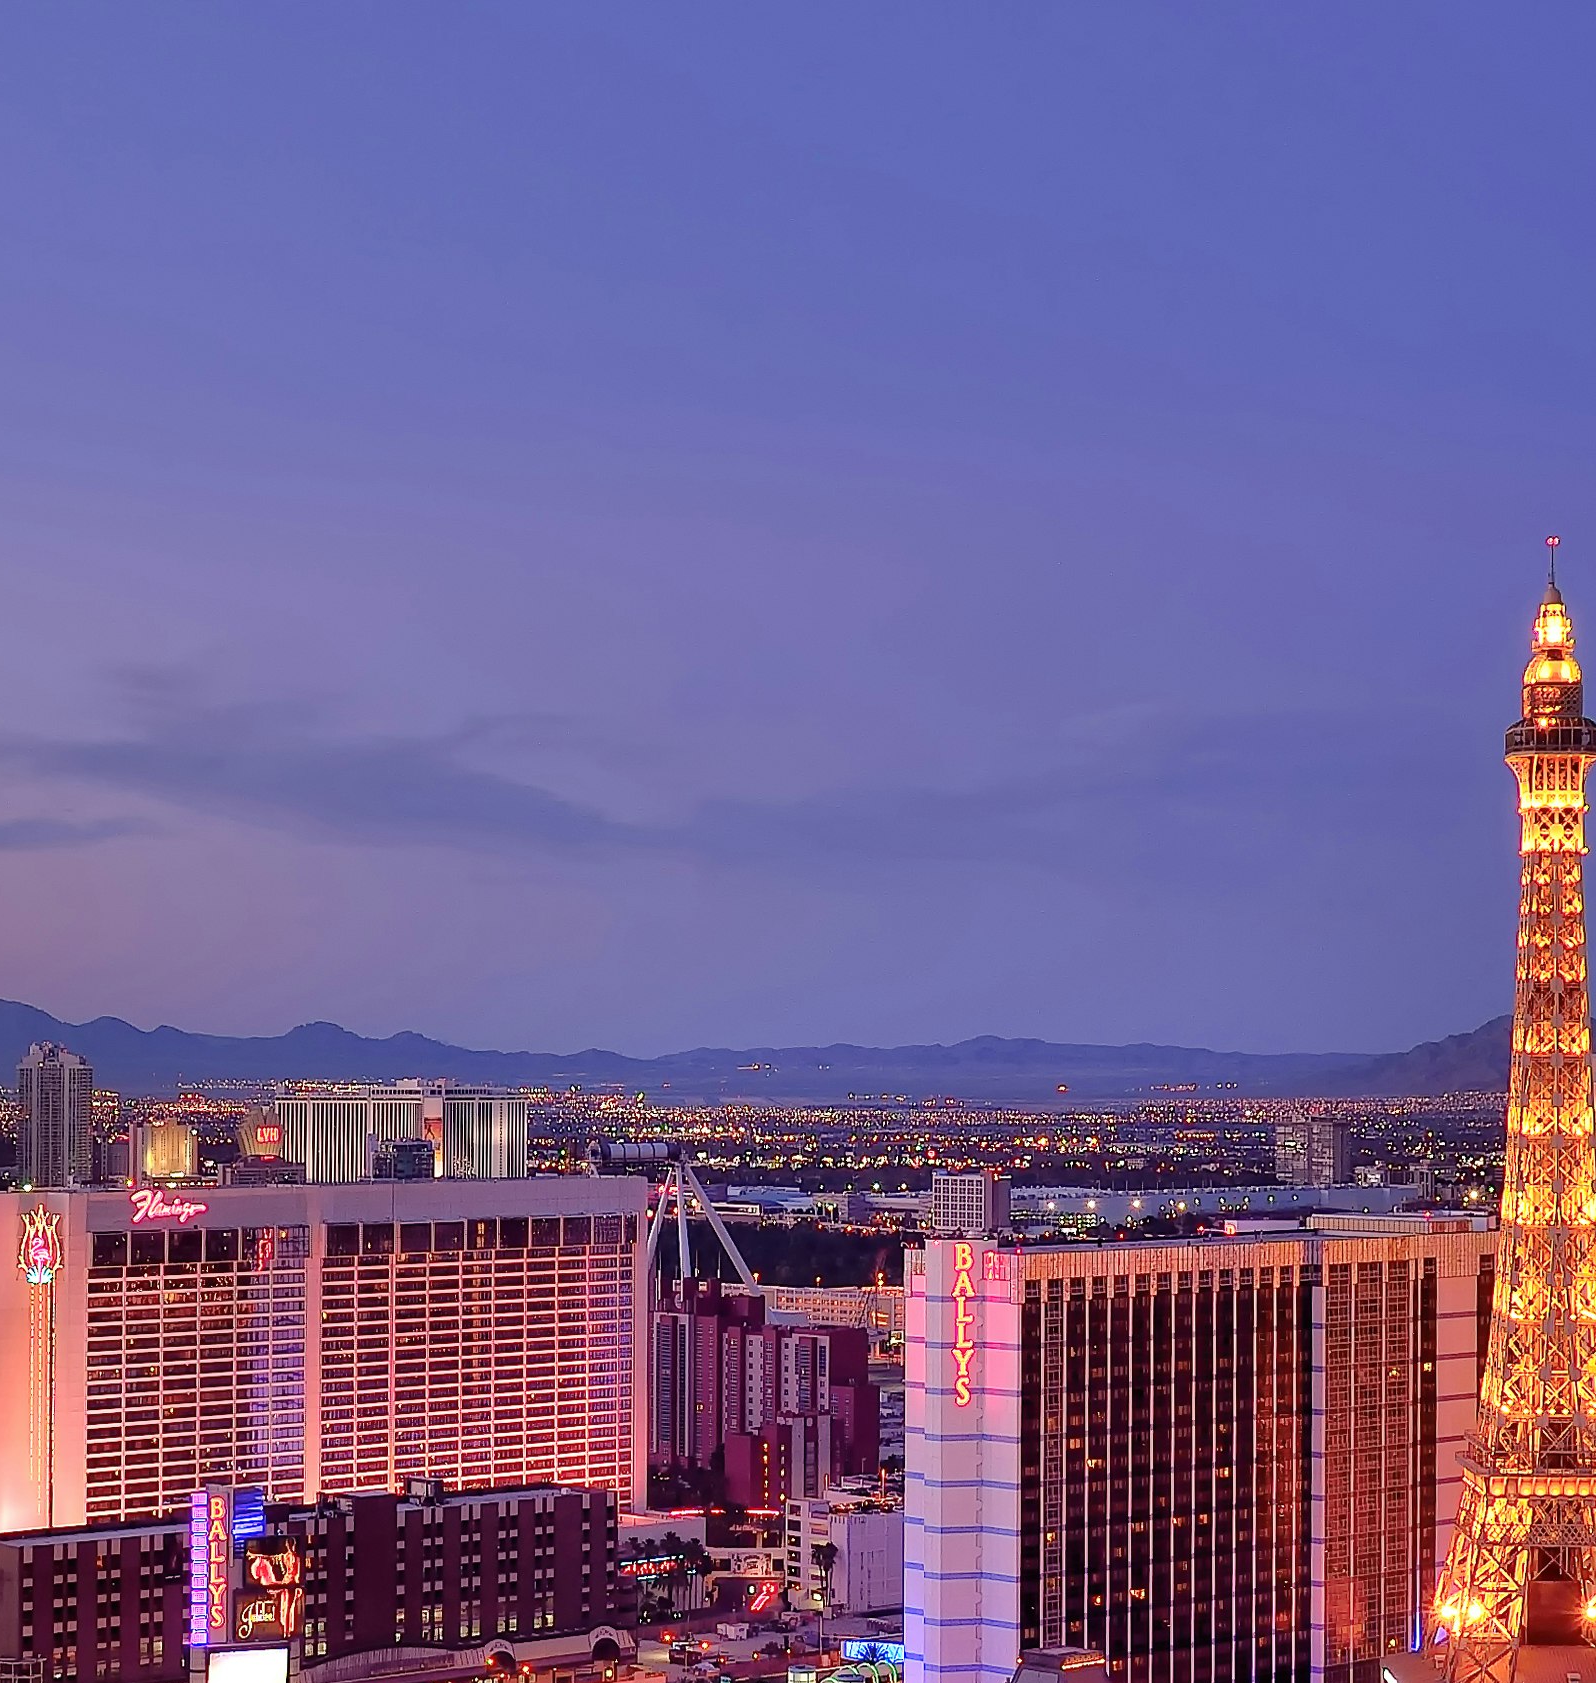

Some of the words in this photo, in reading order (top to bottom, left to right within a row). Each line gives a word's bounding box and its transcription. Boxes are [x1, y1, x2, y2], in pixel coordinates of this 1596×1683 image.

[130, 1190, 207, 1224] Flamingo
[952, 1242, 975, 1407] BALLYS
[208, 1497, 227, 1628] BALLYS
